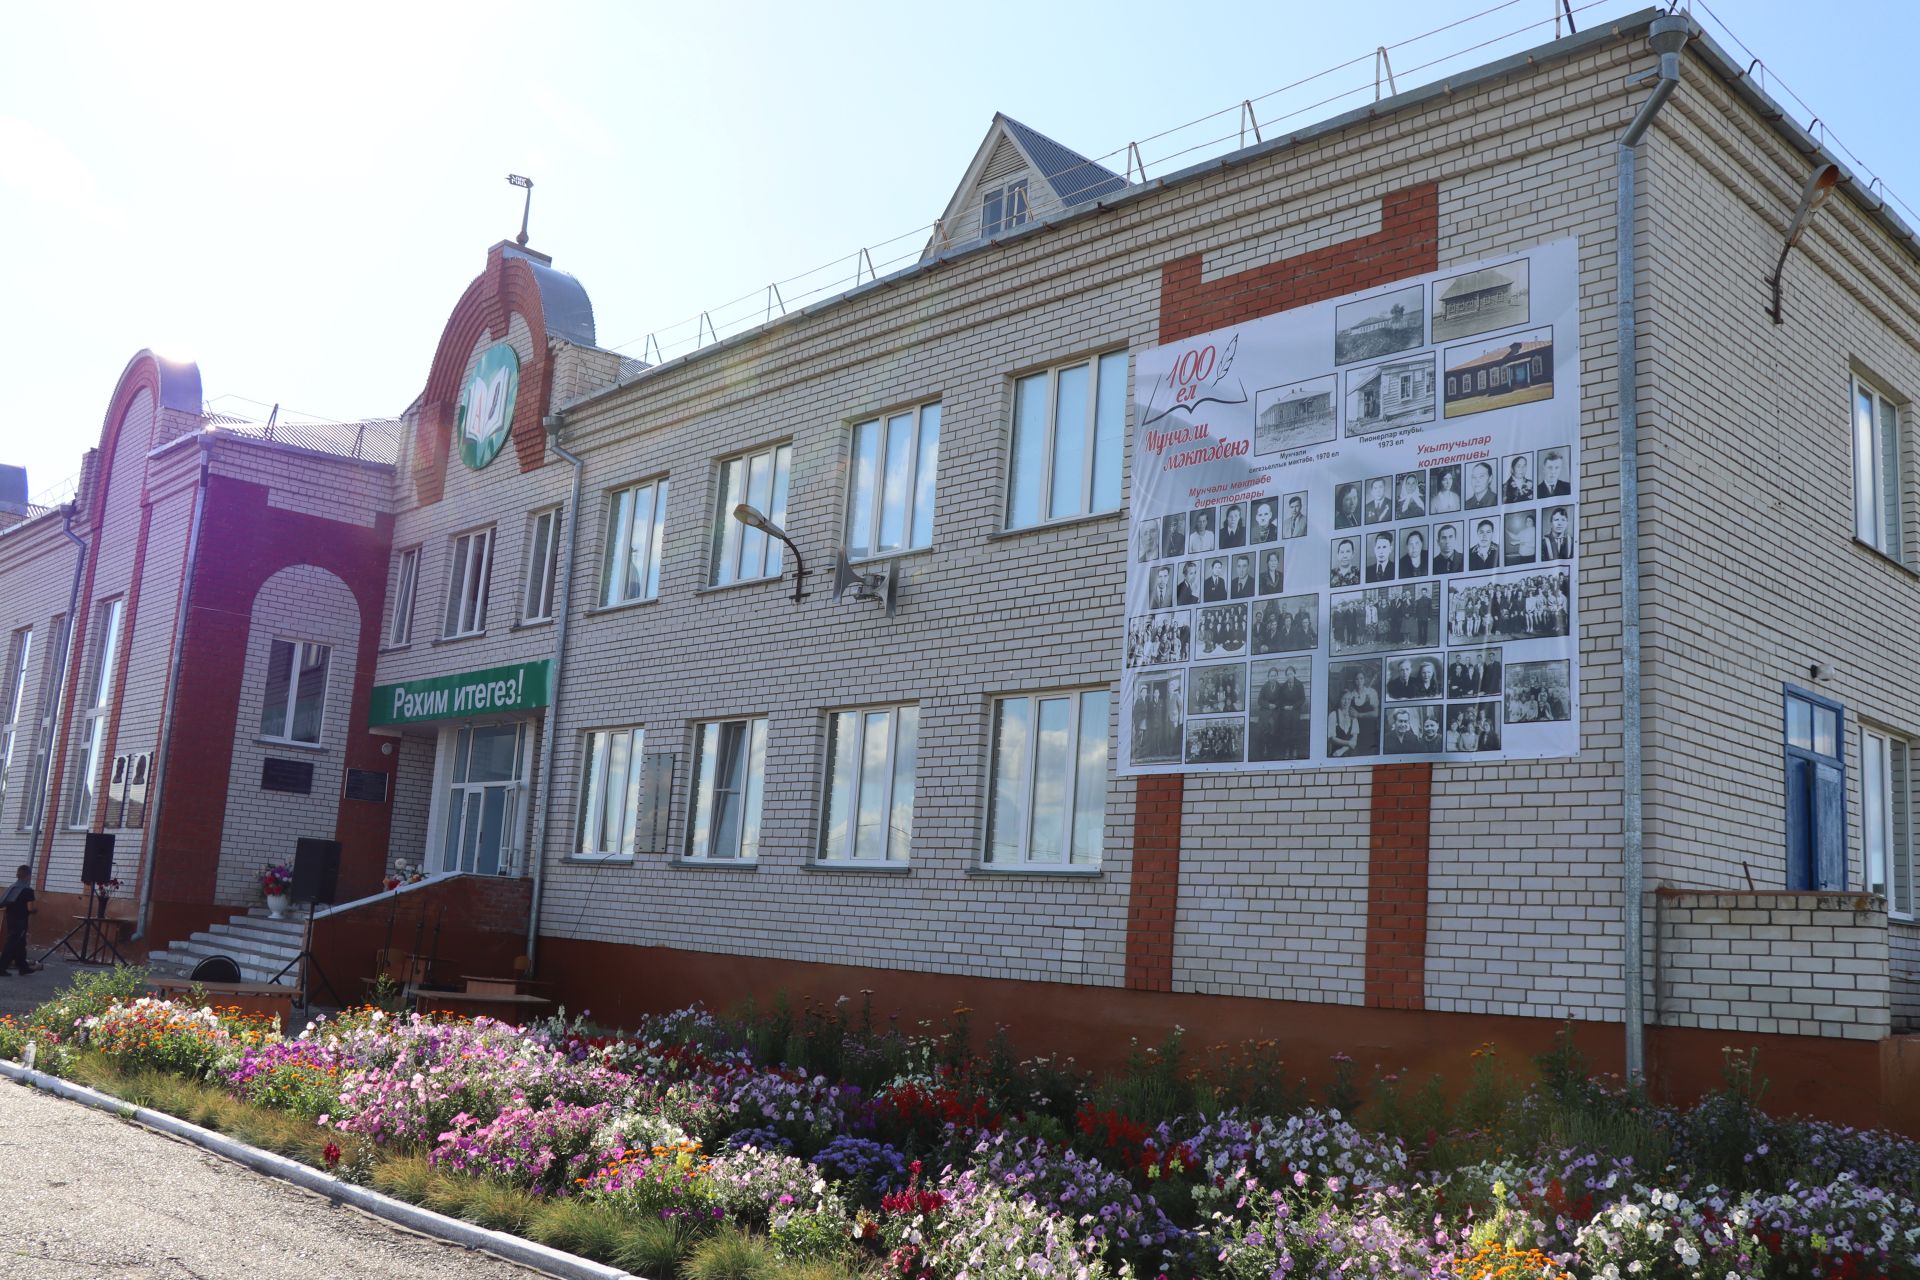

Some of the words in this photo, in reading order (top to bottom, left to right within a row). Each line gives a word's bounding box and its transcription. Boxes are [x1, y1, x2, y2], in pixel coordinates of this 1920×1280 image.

[1165, 345, 1216, 389] 100
[1176, 383, 1197, 403] ел
[1145, 423, 1210, 456] Мунчәли
[1359, 431, 1397, 444] Пионерлар
[1378, 440, 1394, 449] 1973
[1417, 435, 1492, 455] Укытучылар
[1163, 435, 1250, 472] мәктәбенә
[1418, 449, 1490, 468] коллективы
[1194, 490, 1265, 508] директорлары
[393, 687, 449, 719] Рәхим
[453, 669, 524, 712] итегез!
